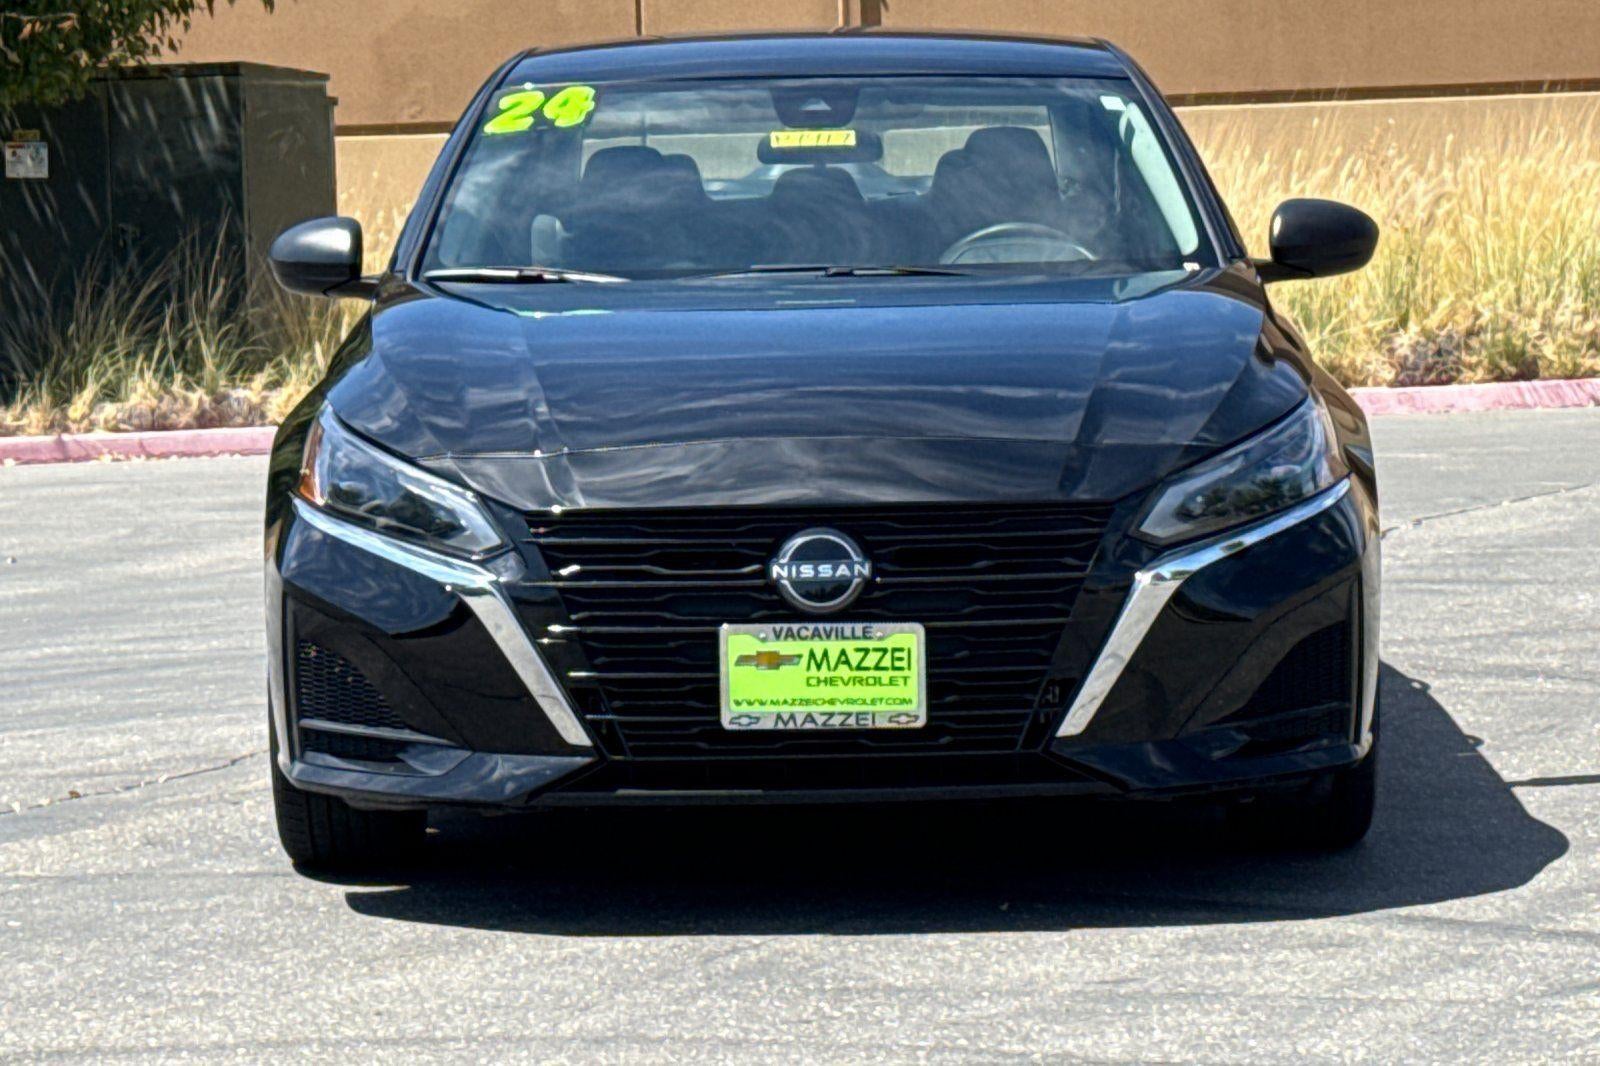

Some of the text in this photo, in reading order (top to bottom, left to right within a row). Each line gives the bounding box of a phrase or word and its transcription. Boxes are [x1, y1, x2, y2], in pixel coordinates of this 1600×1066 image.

[483, 86, 595, 133] 24
[772, 564, 869, 578] NISSAN
[772, 626, 874, 641] VACAVILLE
[806, 647, 912, 672] MAZZEI
[806, 676, 911, 688] CHEVROLET
[773, 712, 876, 728] MAZZEI
